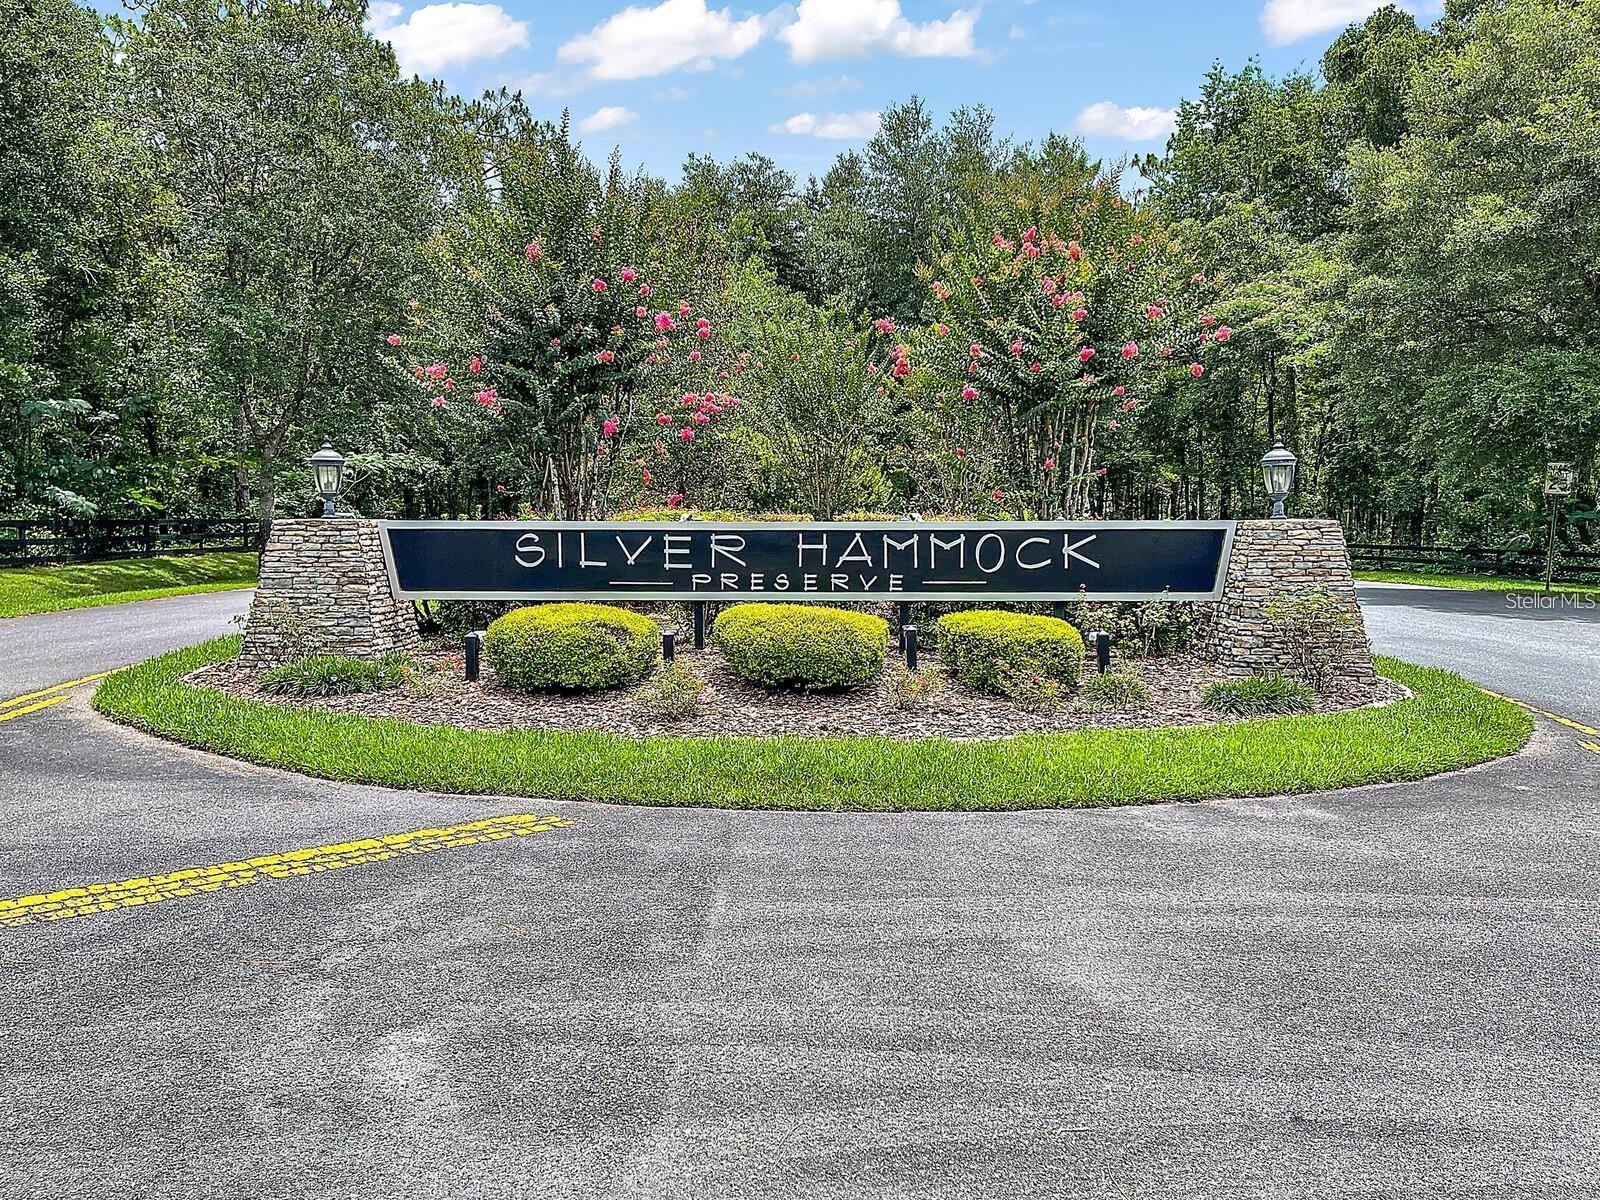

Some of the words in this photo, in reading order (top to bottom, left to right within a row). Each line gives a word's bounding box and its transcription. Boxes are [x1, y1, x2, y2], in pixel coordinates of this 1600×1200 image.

[514, 532, 747, 571] SILVER
[797, 532, 1100, 573] HAMMOCK
[691, 572, 904, 592] PRESERVE
